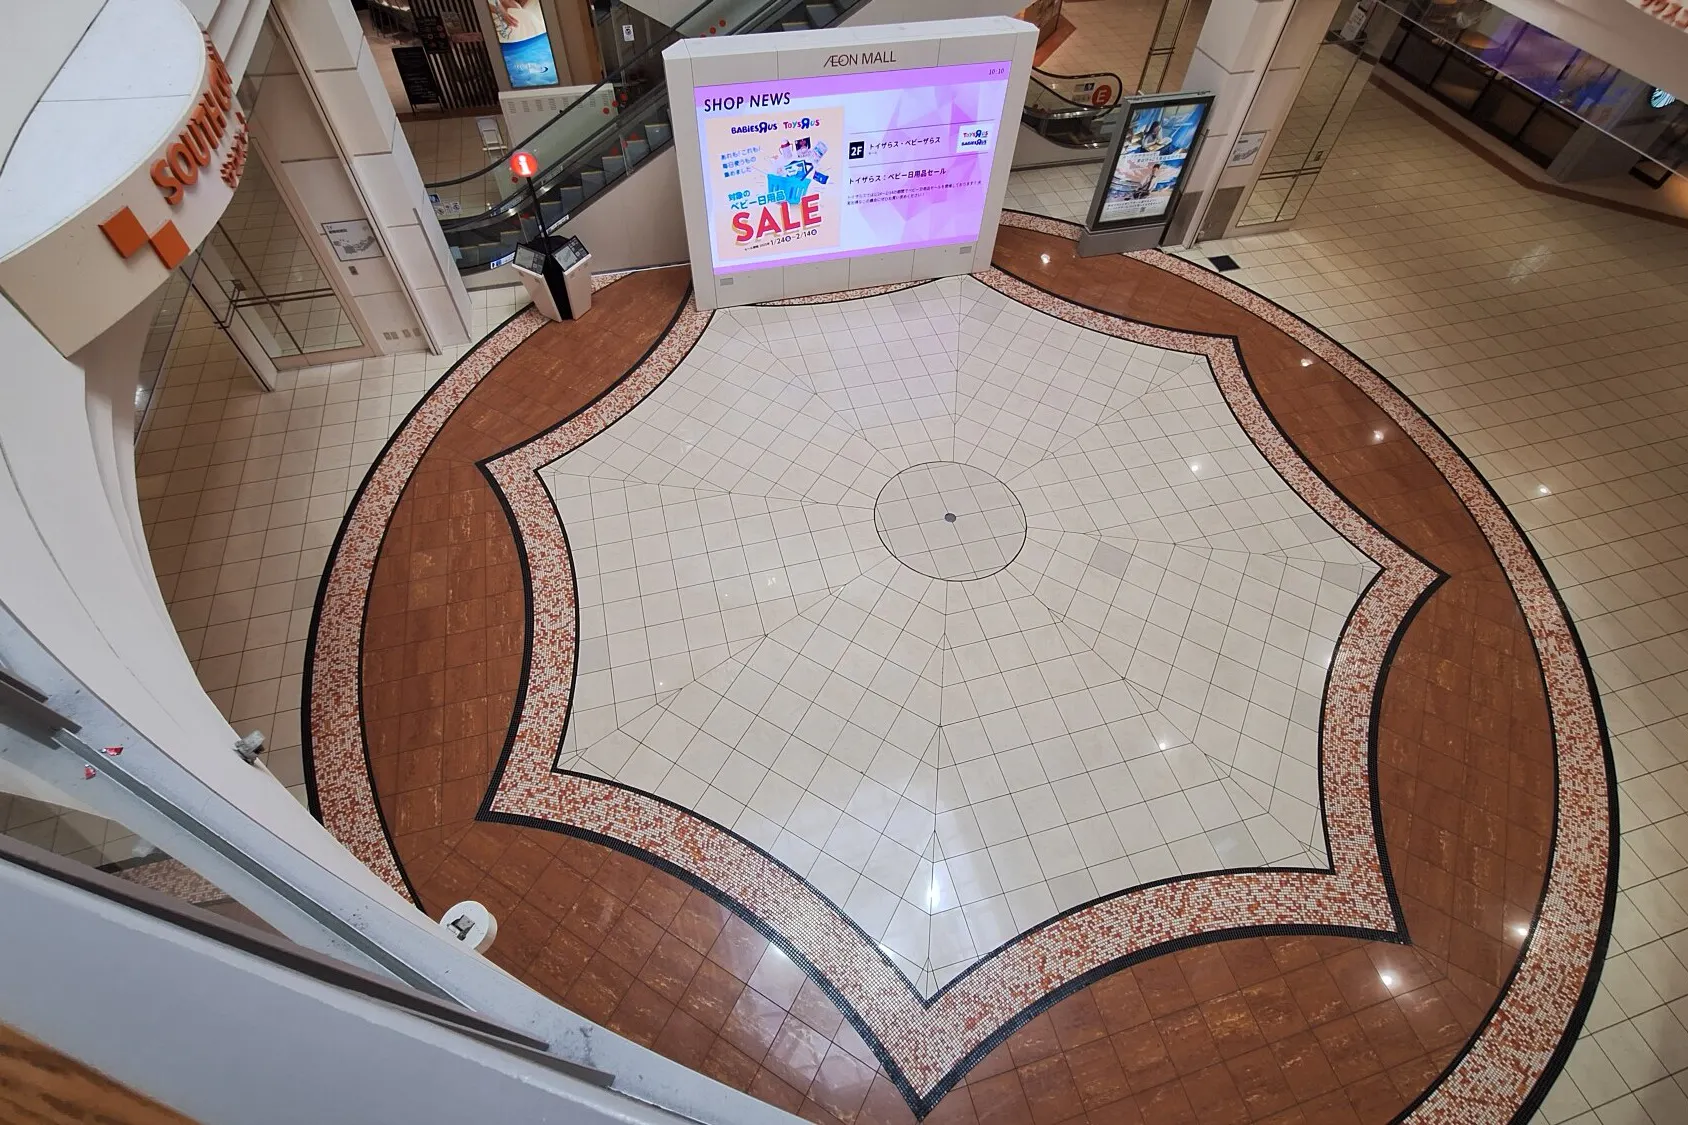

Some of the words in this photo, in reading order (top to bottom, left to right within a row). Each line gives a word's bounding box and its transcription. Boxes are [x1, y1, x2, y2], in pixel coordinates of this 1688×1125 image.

[861, 50, 897, 65] MALL
[704, 96, 744, 113] SHOP
[749, 91, 791, 108] NEWS
[149, 88, 228, 206] SOUTH
[850, 145, 863, 157] 2F
[732, 193, 822, 242] SALE
